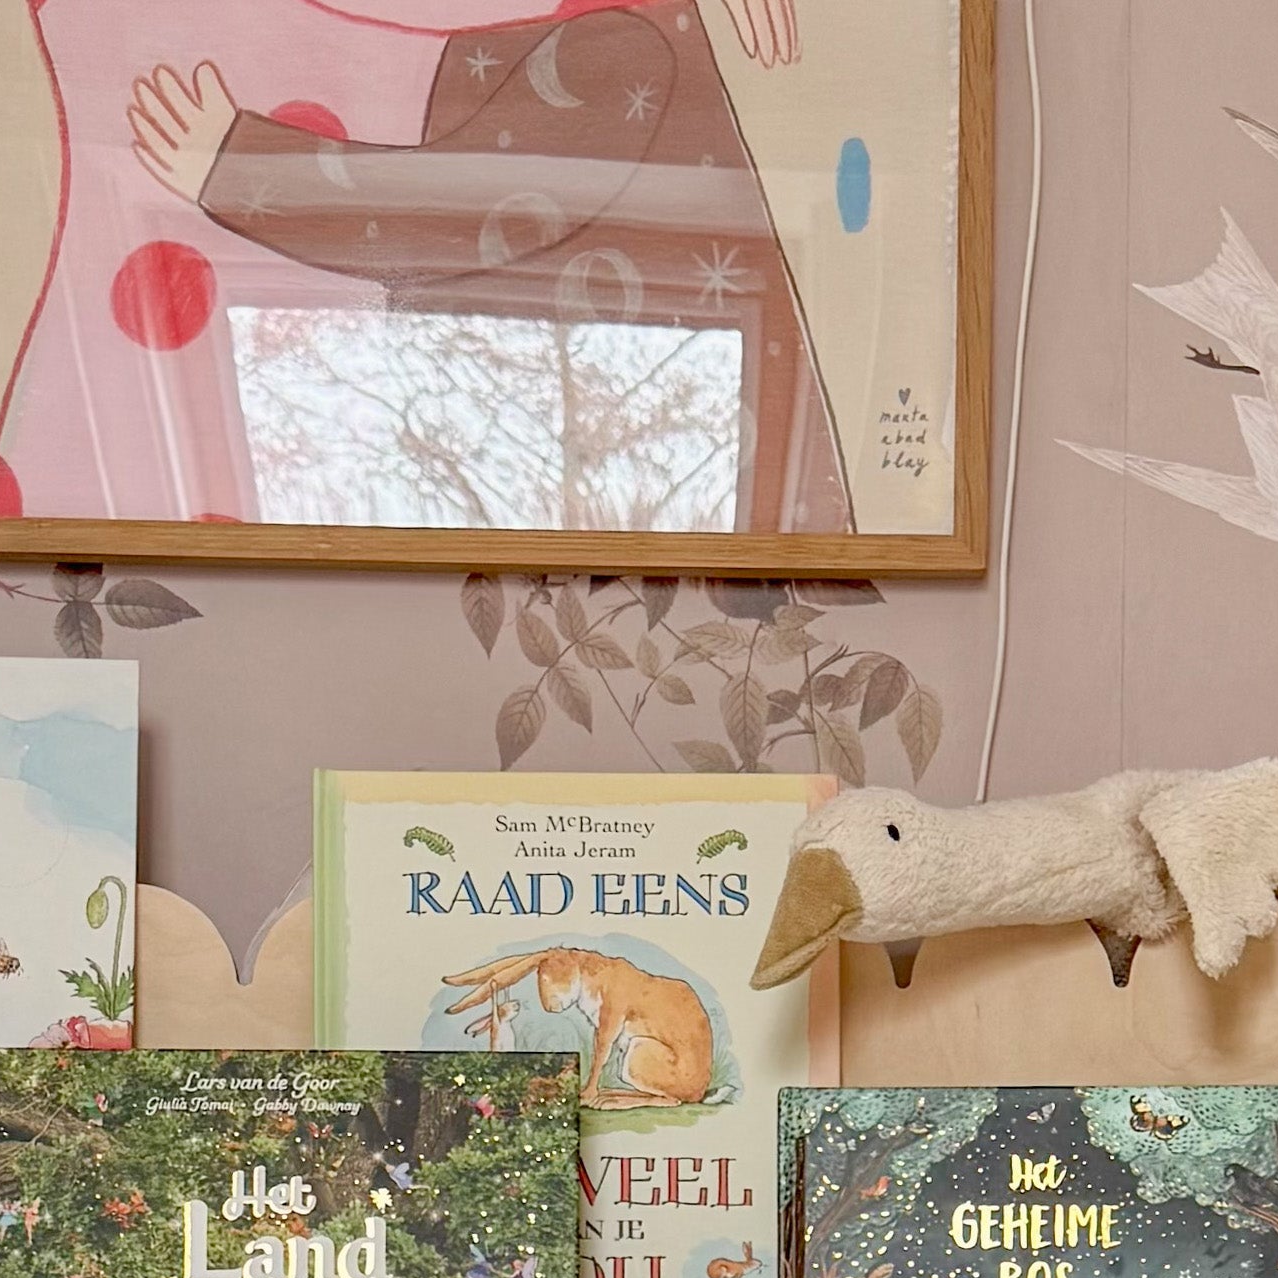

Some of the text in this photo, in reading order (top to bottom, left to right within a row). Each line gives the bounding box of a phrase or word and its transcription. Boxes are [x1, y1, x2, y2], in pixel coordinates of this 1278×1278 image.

[879, 405, 929, 423] marta
[881, 428, 926, 445] abad
[881, 450, 930, 477] blay
[495, 815, 655, 839] Sam McBratney
[515, 840, 636, 858] Anita Jeram
[402, 870, 751, 918] RAAD EENS
[180, 1071, 340, 1099] Lars van de Goor
[145, 1096, 361, 1117] Giulia Tomai Gabby Dawnay
[1008, 1153, 1068, 1194] Het
[222, 1166, 316, 1219] Het
[614, 1219, 645, 1241] JE
[949, 1201, 1122, 1251] GEHEIME
